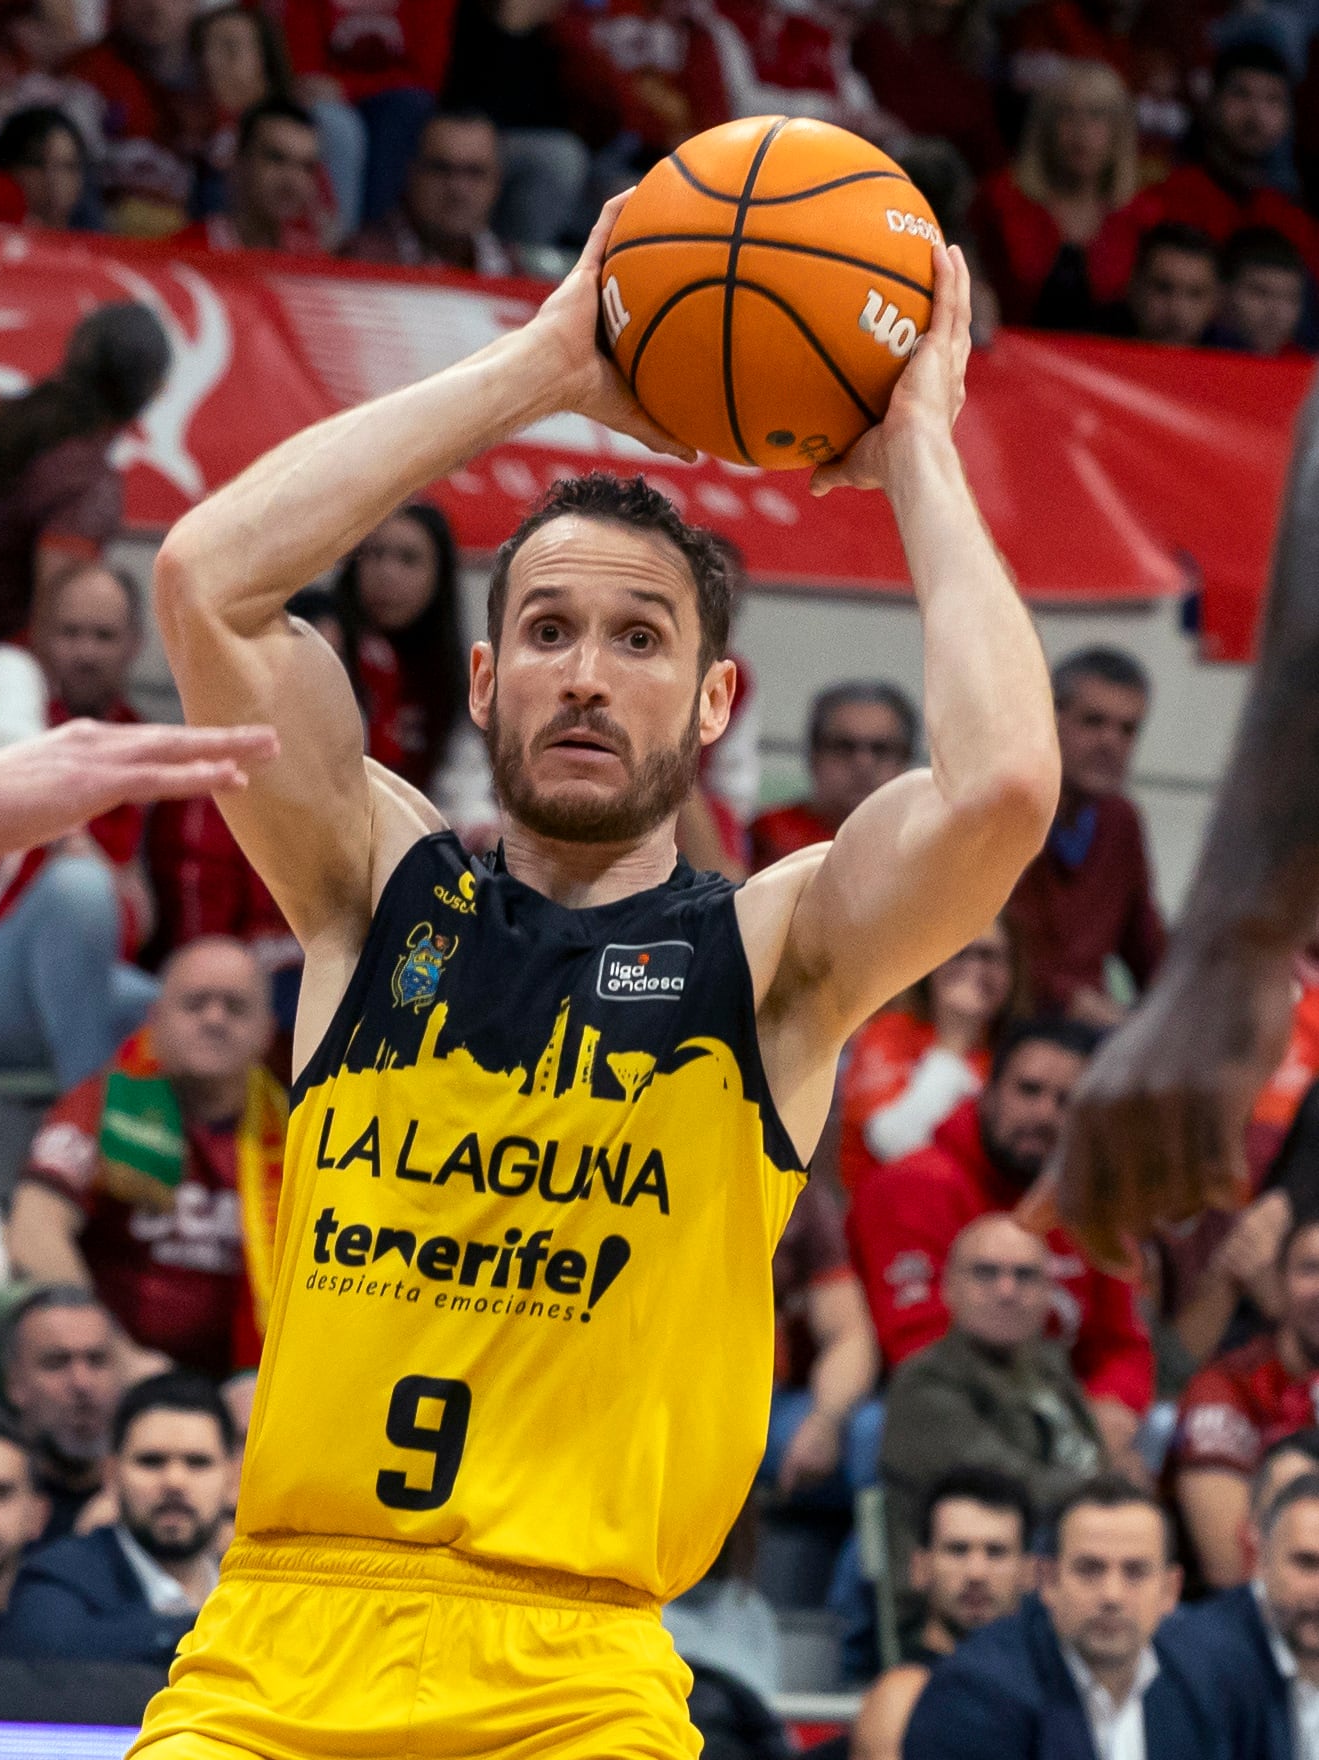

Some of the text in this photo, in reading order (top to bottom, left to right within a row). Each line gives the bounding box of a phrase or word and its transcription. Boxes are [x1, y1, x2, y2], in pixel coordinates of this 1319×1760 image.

[607, 975, 685, 993] endesa
[609, 961, 646, 980] liga
[316, 1106, 670, 1216] LA LAGUNA
[305, 1269, 574, 1323] despierta emociones
[376, 1374, 473, 1512] 9
